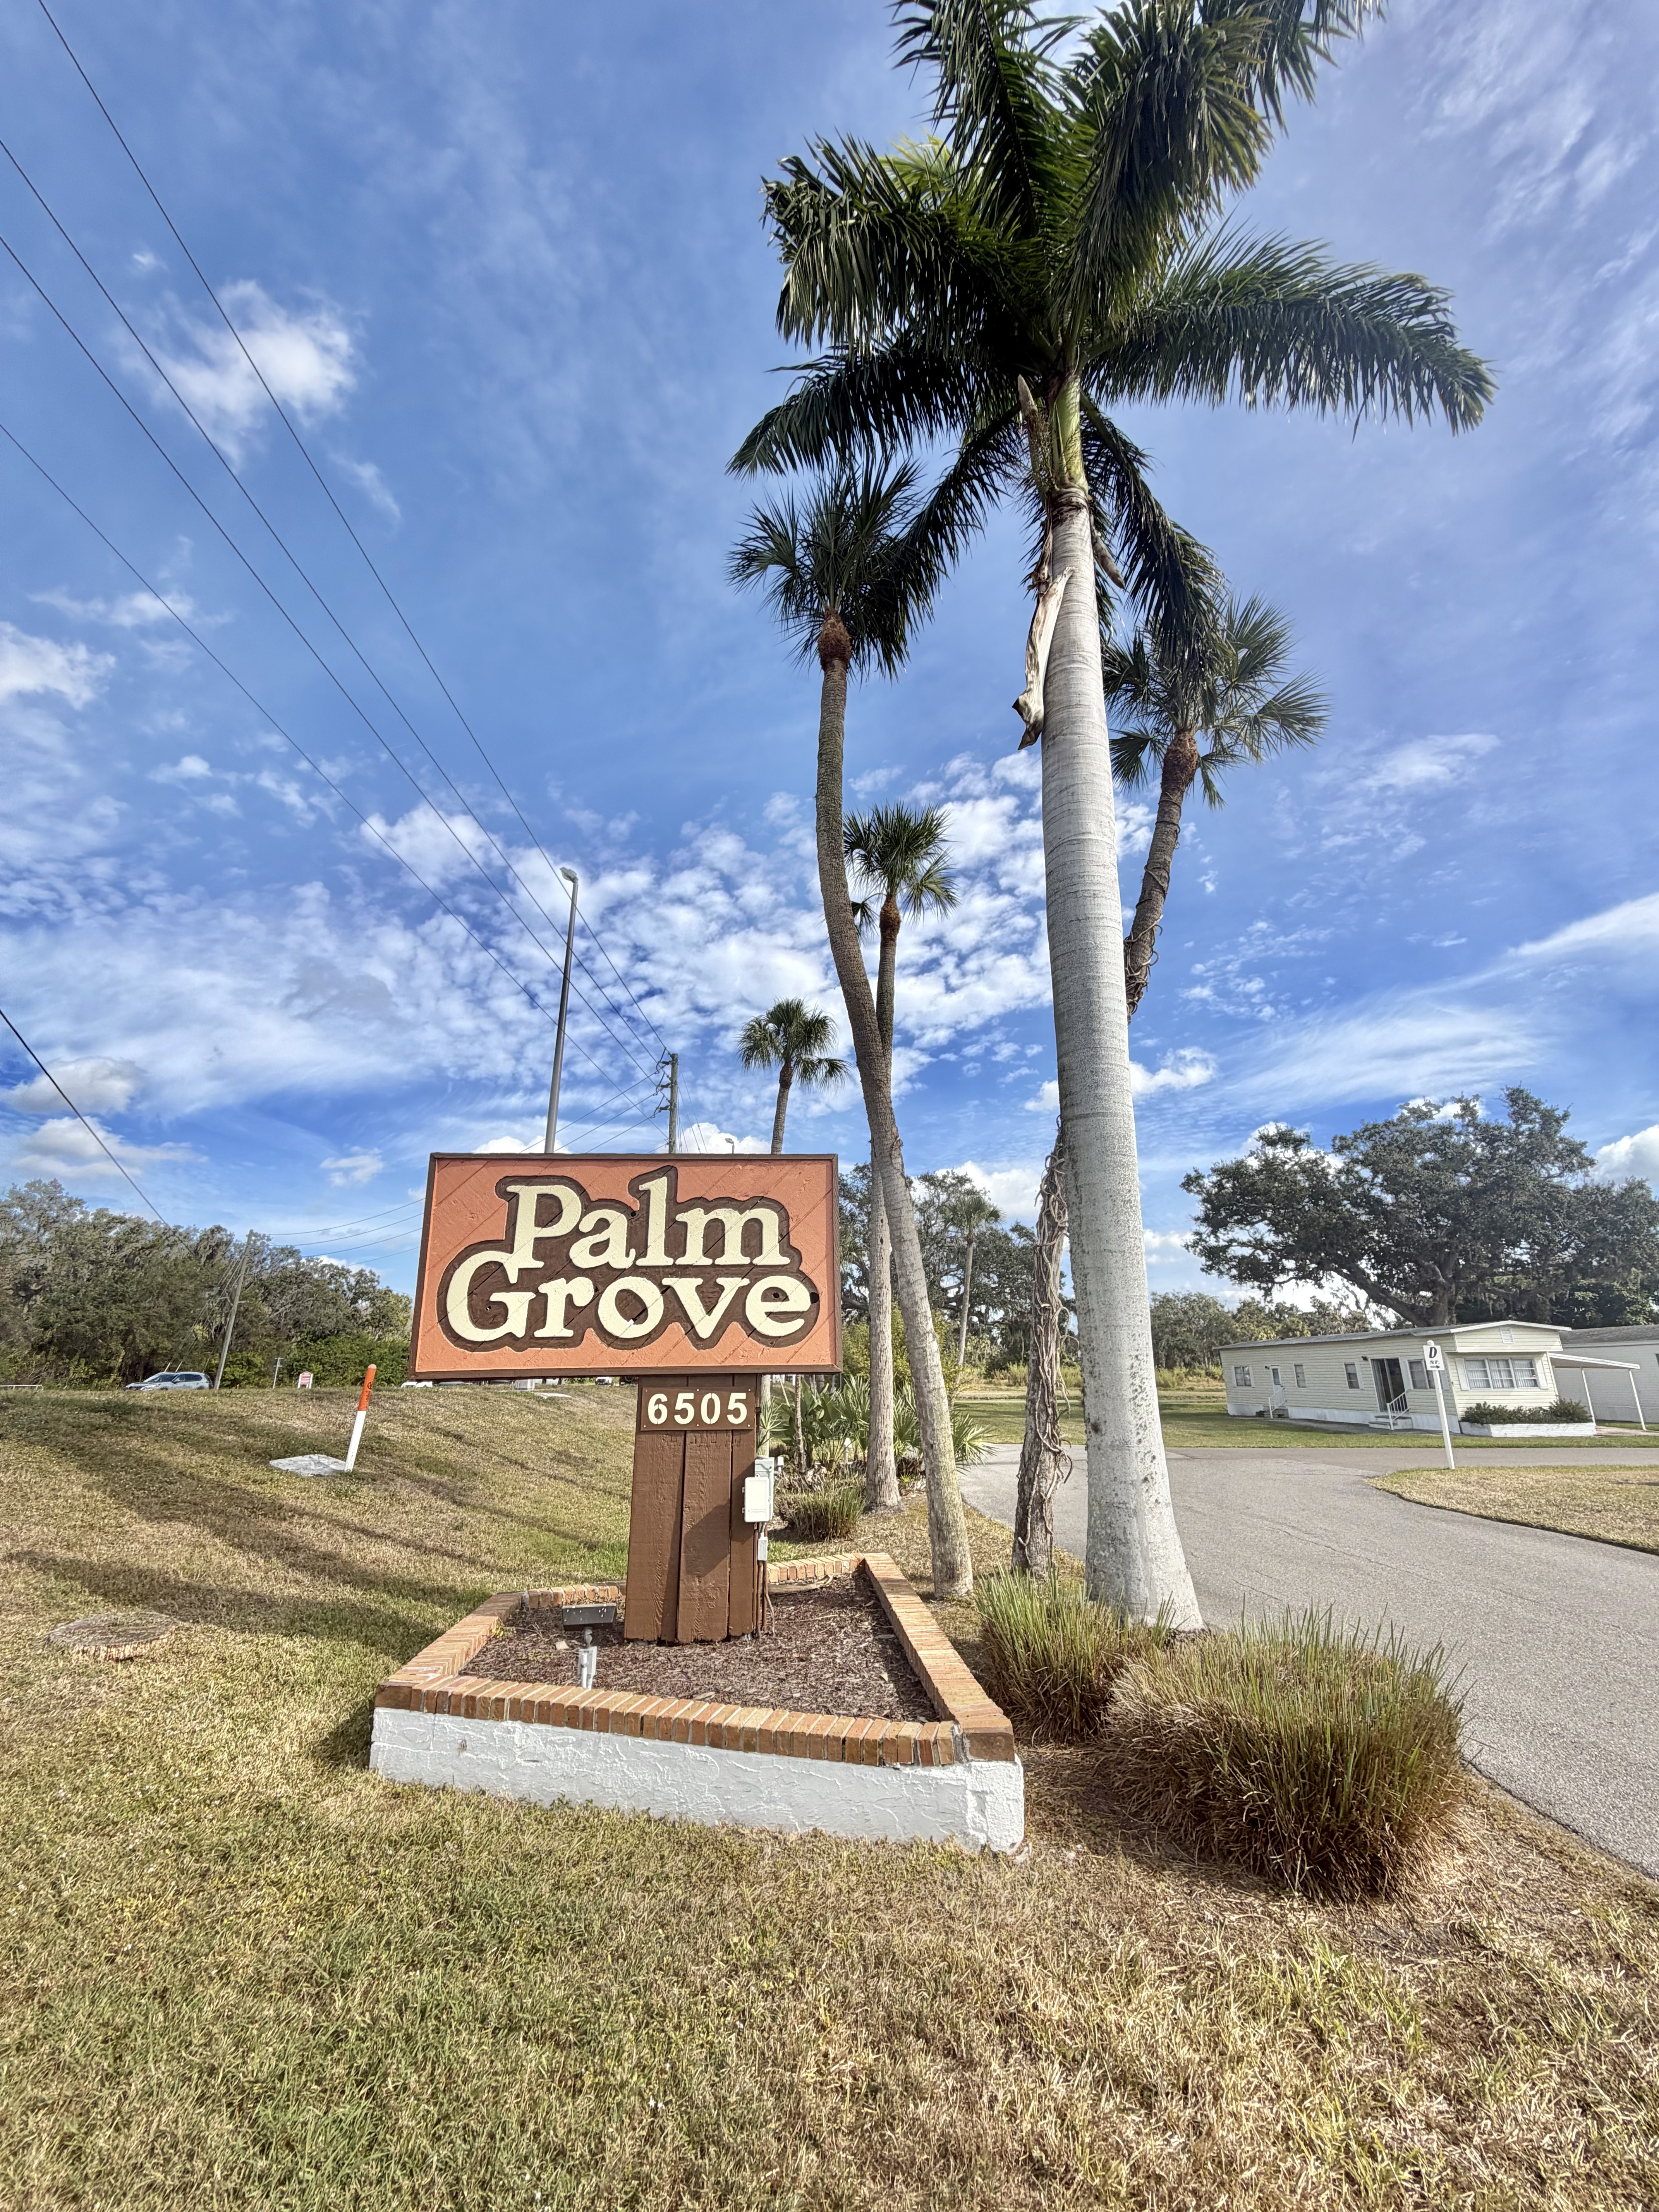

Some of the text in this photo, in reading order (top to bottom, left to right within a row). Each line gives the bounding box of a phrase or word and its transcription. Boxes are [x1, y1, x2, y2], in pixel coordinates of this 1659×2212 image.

[506, 1176, 791, 1269] Palm
[447, 1250, 811, 1342] Grove
[1429, 1347, 1437, 1358] D
[648, 1393, 747, 1424] 6505
